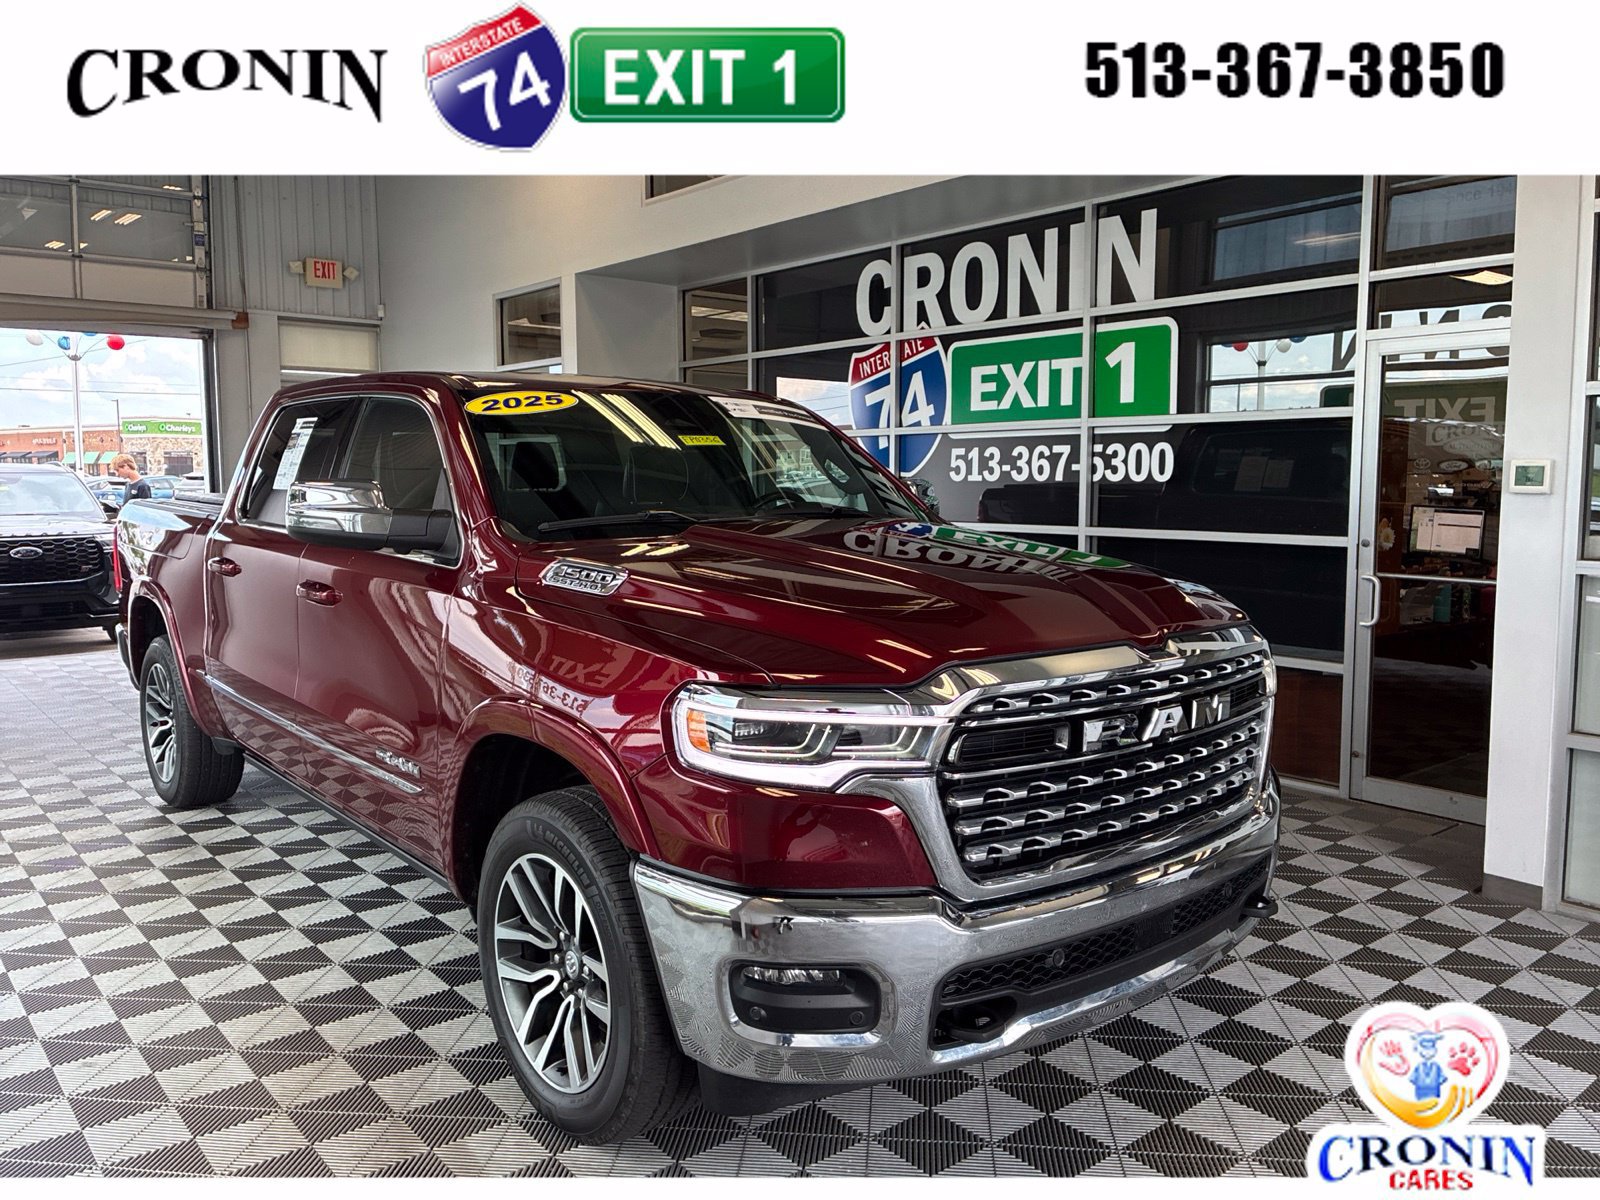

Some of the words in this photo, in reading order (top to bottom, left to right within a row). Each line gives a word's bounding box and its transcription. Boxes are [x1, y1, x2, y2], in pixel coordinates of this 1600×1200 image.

[313, 260, 337, 280] EXIT
[856, 208, 1157, 337] CRONIN
[859, 339, 925, 378] INTERATE
[969, 356, 1083, 411] EXIT
[1104, 341, 1137, 403] 1
[481, 393, 564, 412] 2025
[864, 370, 935, 450] 74
[949, 442, 1175, 483] 513-367-5300
[558, 565, 613, 584] 1500
[1082, 695, 1231, 752] RAM
[543, 829, 592, 888] MICHELIN
